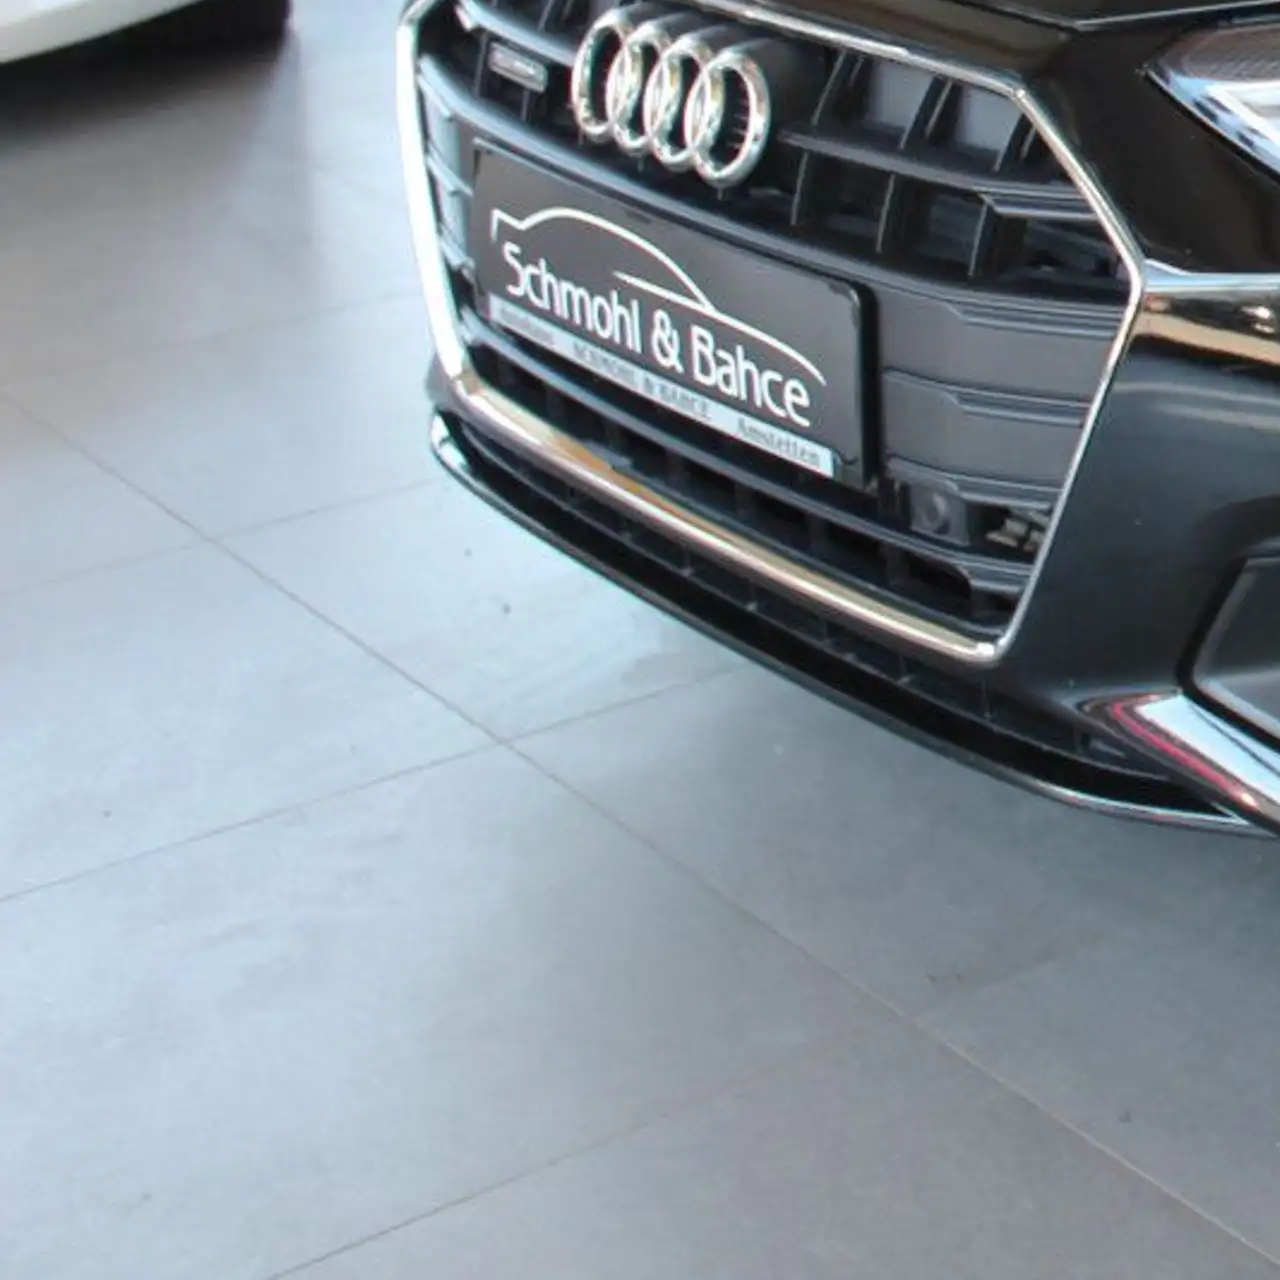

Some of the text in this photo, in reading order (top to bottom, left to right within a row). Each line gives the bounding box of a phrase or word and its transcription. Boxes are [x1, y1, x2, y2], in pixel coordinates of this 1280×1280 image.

[503, 241, 641, 353] Schmohl
[652, 310, 682, 373] &
[691, 325, 810, 427] Bahce
